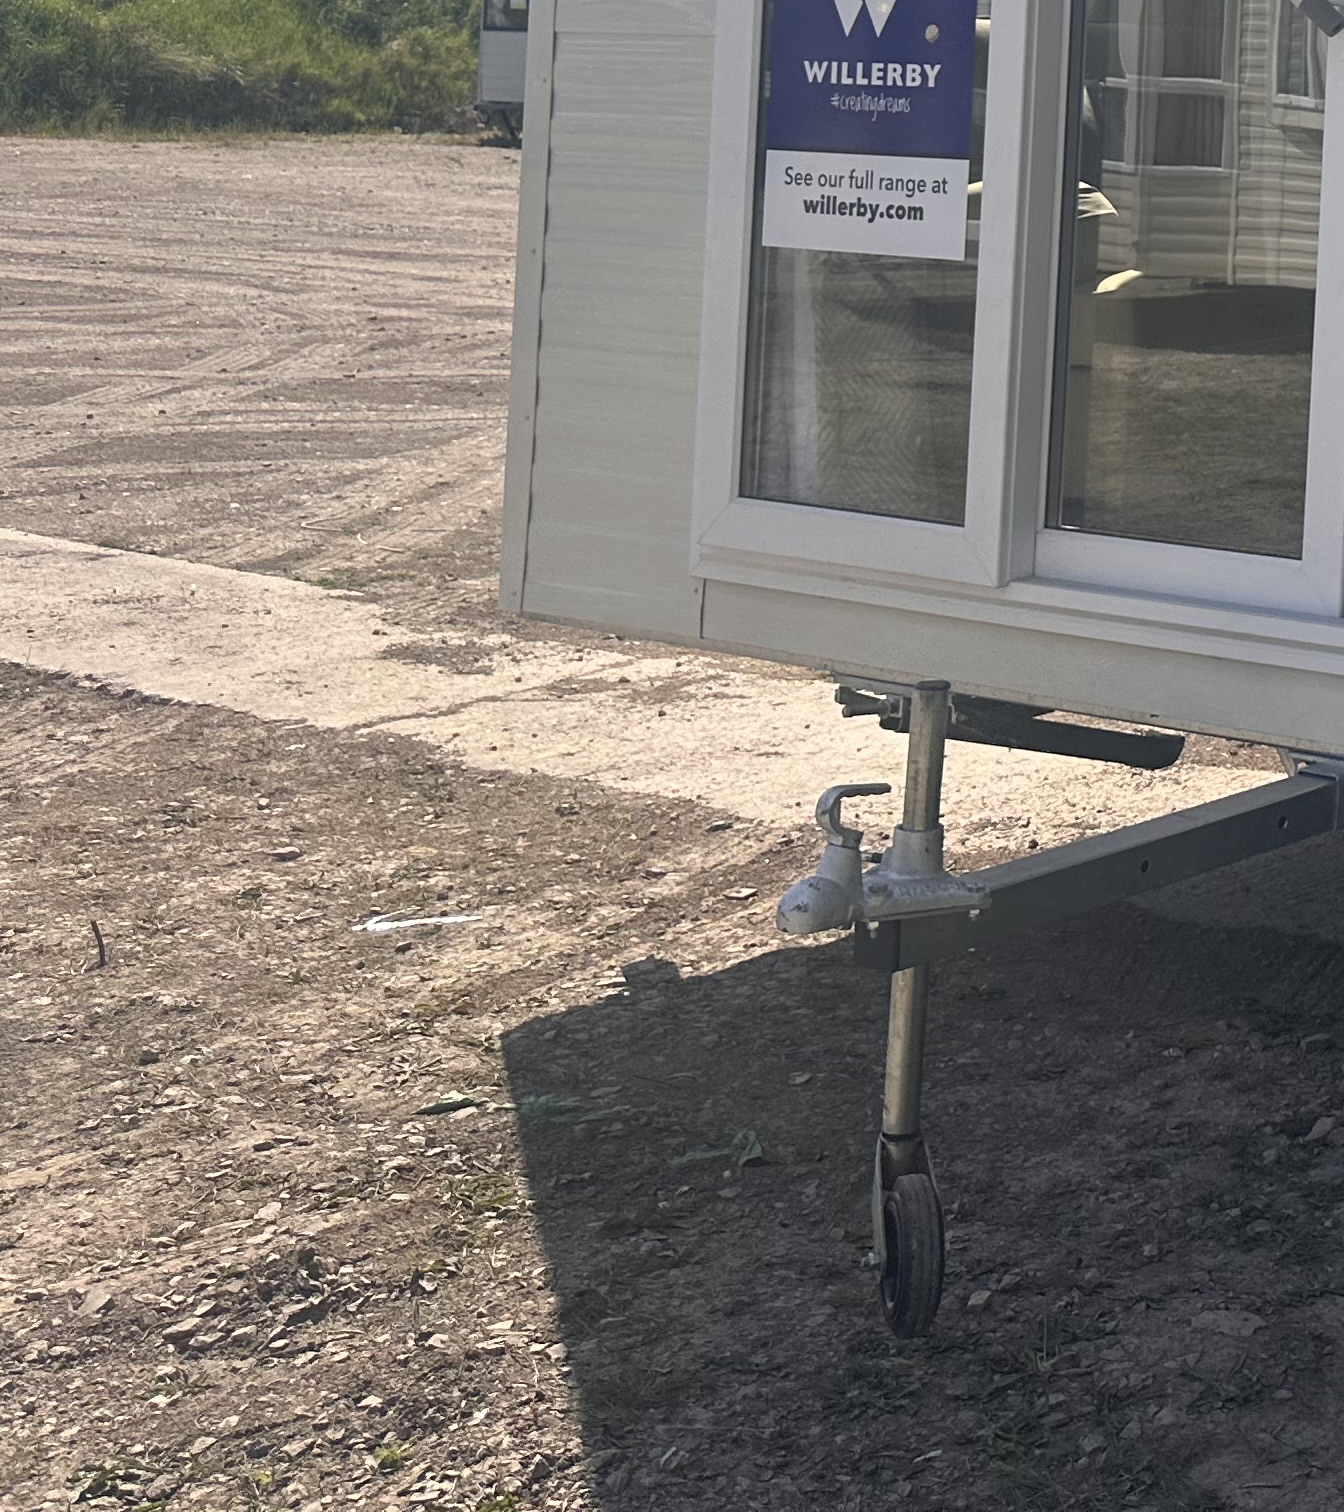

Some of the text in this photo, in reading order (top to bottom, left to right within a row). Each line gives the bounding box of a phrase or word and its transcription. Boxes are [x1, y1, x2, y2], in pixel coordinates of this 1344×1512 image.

[803, 60, 942, 88] WILLERBY
[830, 90, 911, 122] #creatingdreams
[784, 166, 949, 198] See our full range at
[803, 193, 925, 224] willerby.com
